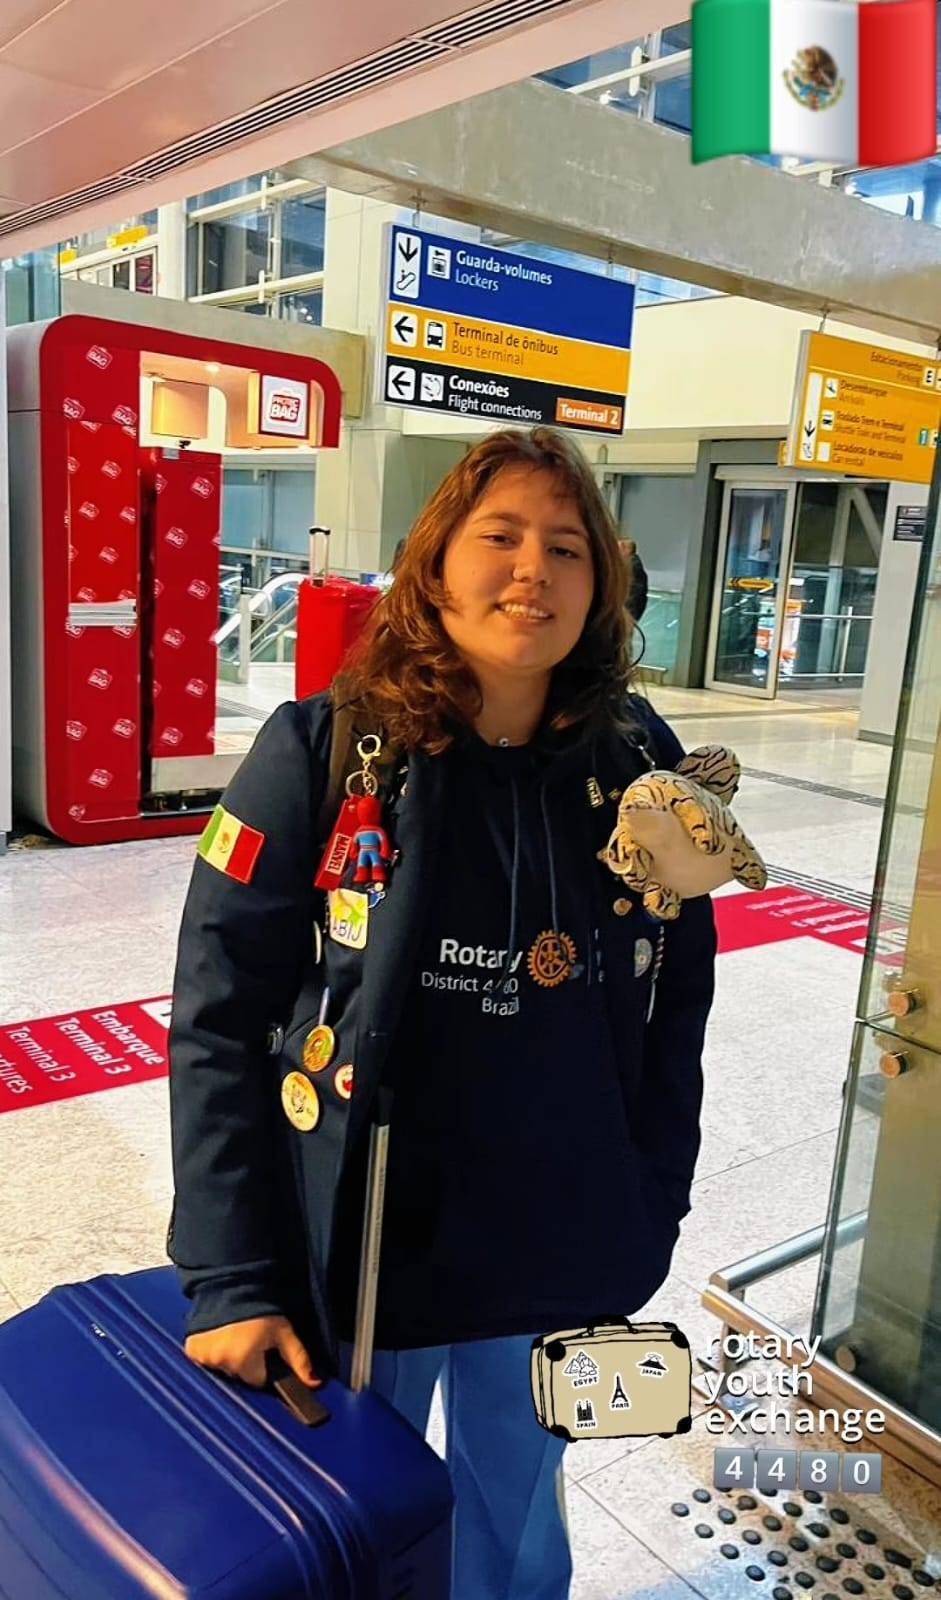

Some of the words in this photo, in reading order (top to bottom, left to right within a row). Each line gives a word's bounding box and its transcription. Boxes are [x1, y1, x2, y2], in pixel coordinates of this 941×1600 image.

[455, 269, 499, 291] Lockers
[456, 250, 553, 285] Guarda-volumes
[453, 321, 503, 345] Terminal
[506, 334, 520, 348] de
[522, 336, 559, 355] ônibus
[452, 340, 473, 357] Bus
[475, 345, 524, 365] terminal
[449, 375, 510, 398] Conexões
[271, 404, 298, 420] BAG
[448, 394, 479, 412] Flight
[481, 402, 542, 420] connections
[560, 404, 608, 423] Terminal
[610, 410, 619, 425] 2
[439, 938, 523, 973] Rotary
[421, 971, 479, 992] District
[53, 1017, 125, 1066] Terminal
[104, 1064, 132, 1075] 3
[91, 1010, 166, 1066] Embarque
[6, 1026, 71, 1073] Terminal
[50, 1071, 76, 1082] 3
